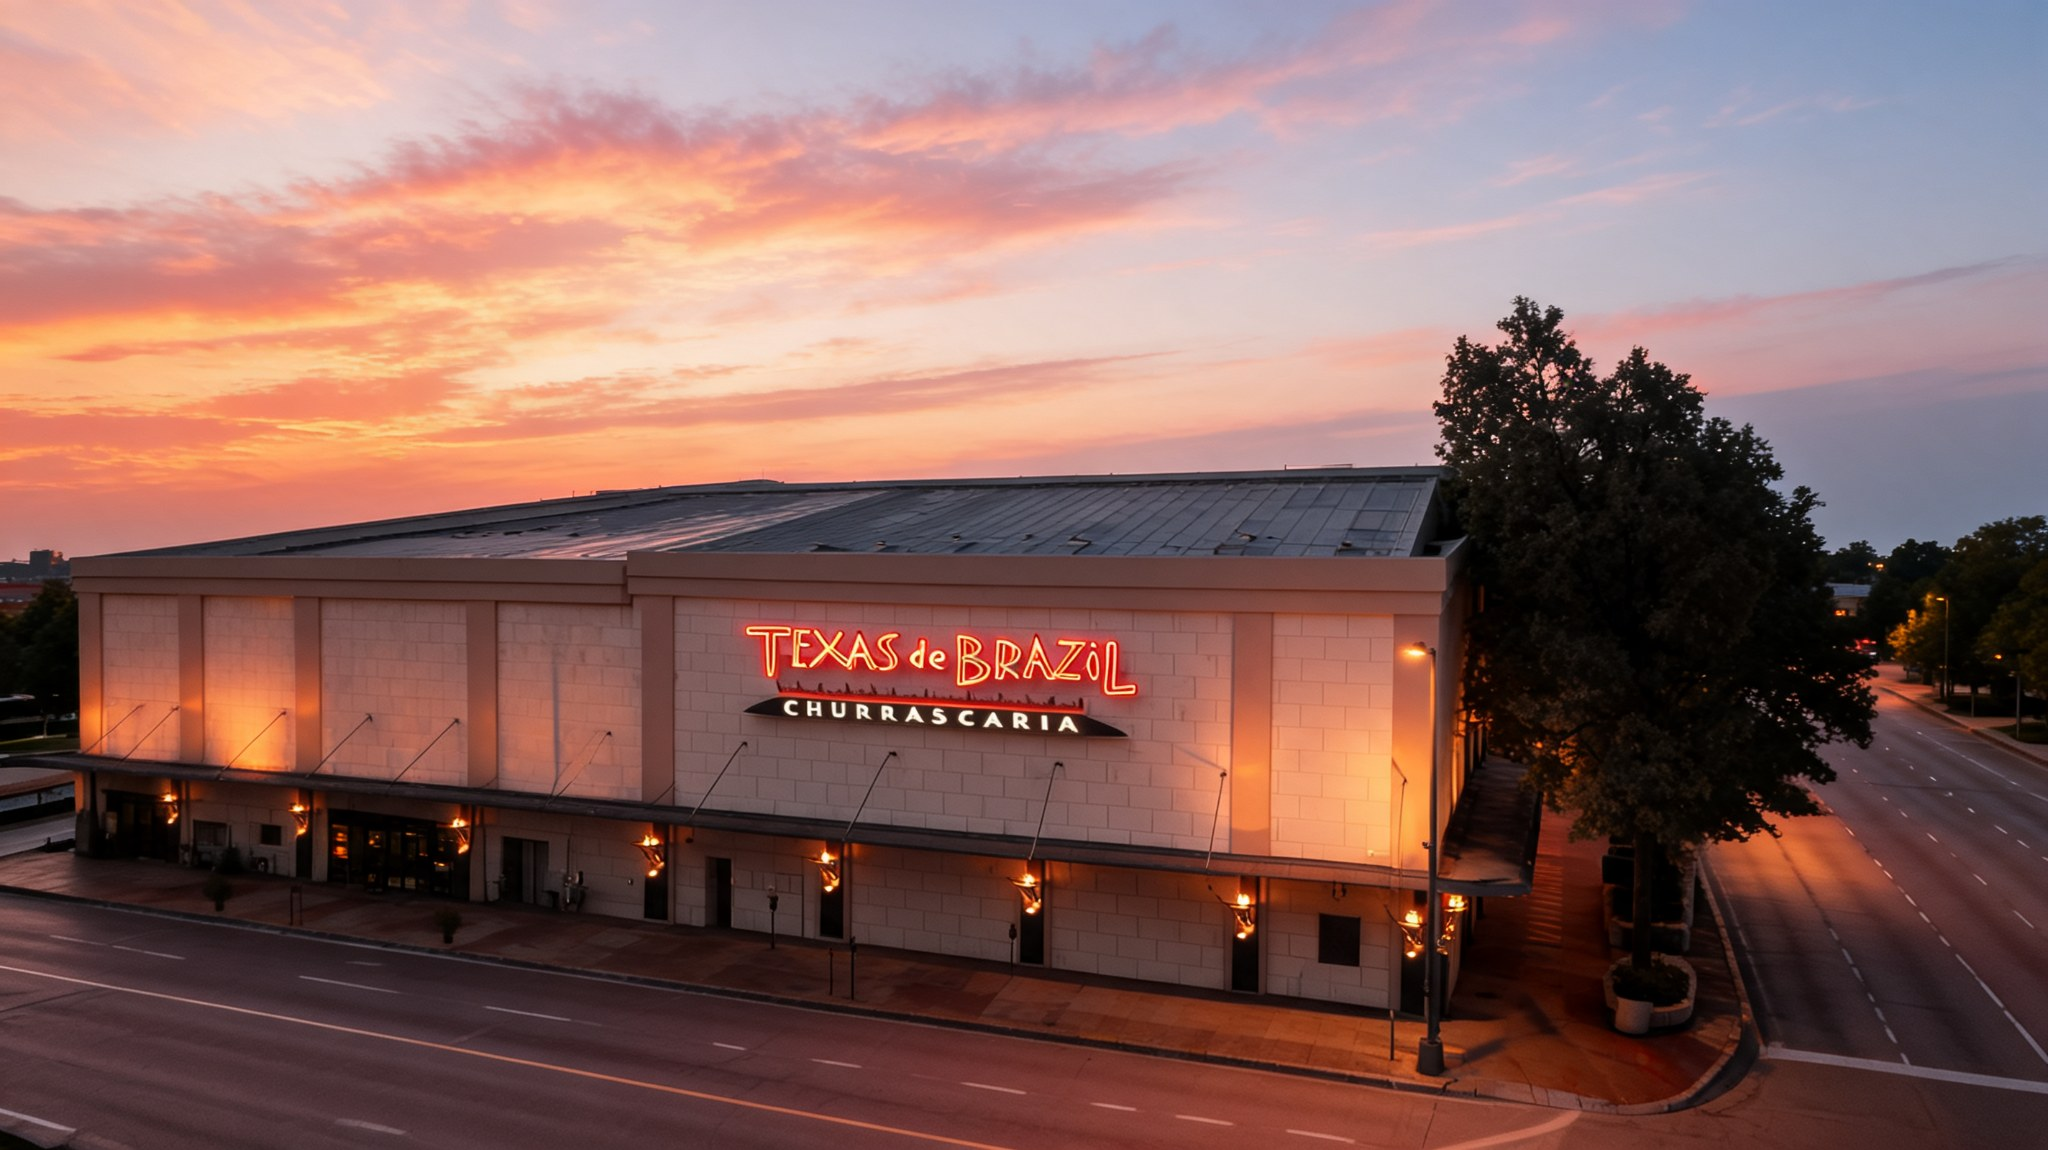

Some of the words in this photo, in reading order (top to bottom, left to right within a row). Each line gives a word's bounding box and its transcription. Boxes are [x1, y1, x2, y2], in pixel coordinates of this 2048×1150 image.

[745, 625, 900, 678] TEXAS
[909, 639, 946, 670] de
[783, 699, 1079, 733] CHURRASCARIA
